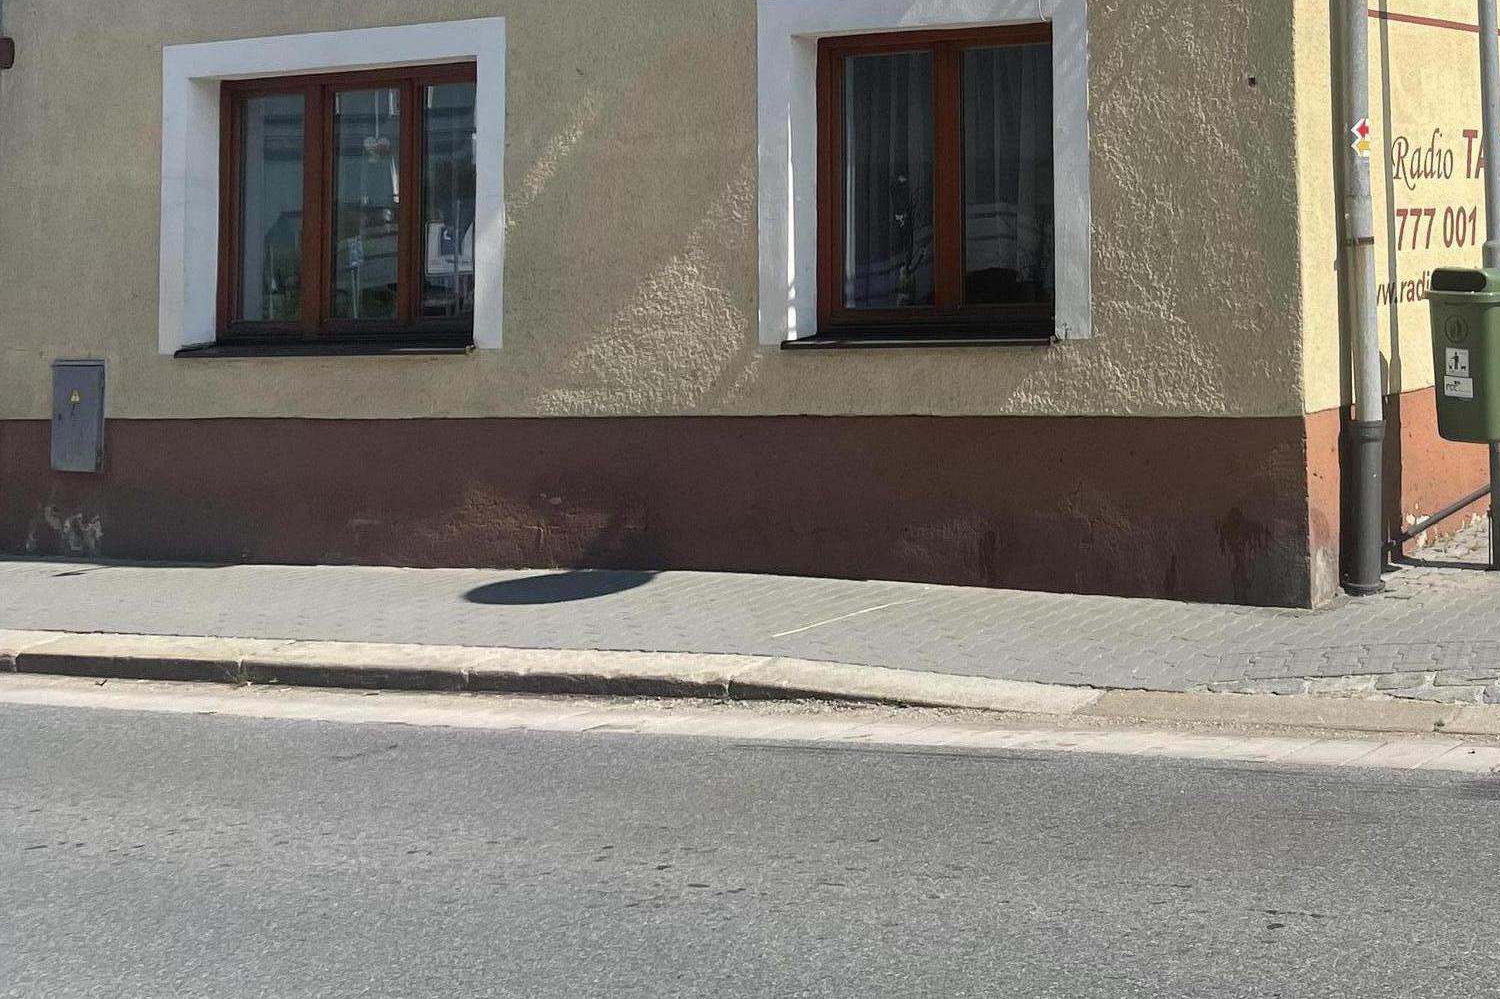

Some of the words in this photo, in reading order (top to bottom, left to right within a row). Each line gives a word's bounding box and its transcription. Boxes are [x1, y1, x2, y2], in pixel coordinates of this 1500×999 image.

[1391, 128, 1454, 190] Radio
[1396, 207, 1436, 251] 777
[1443, 205, 1477, 248] 001
